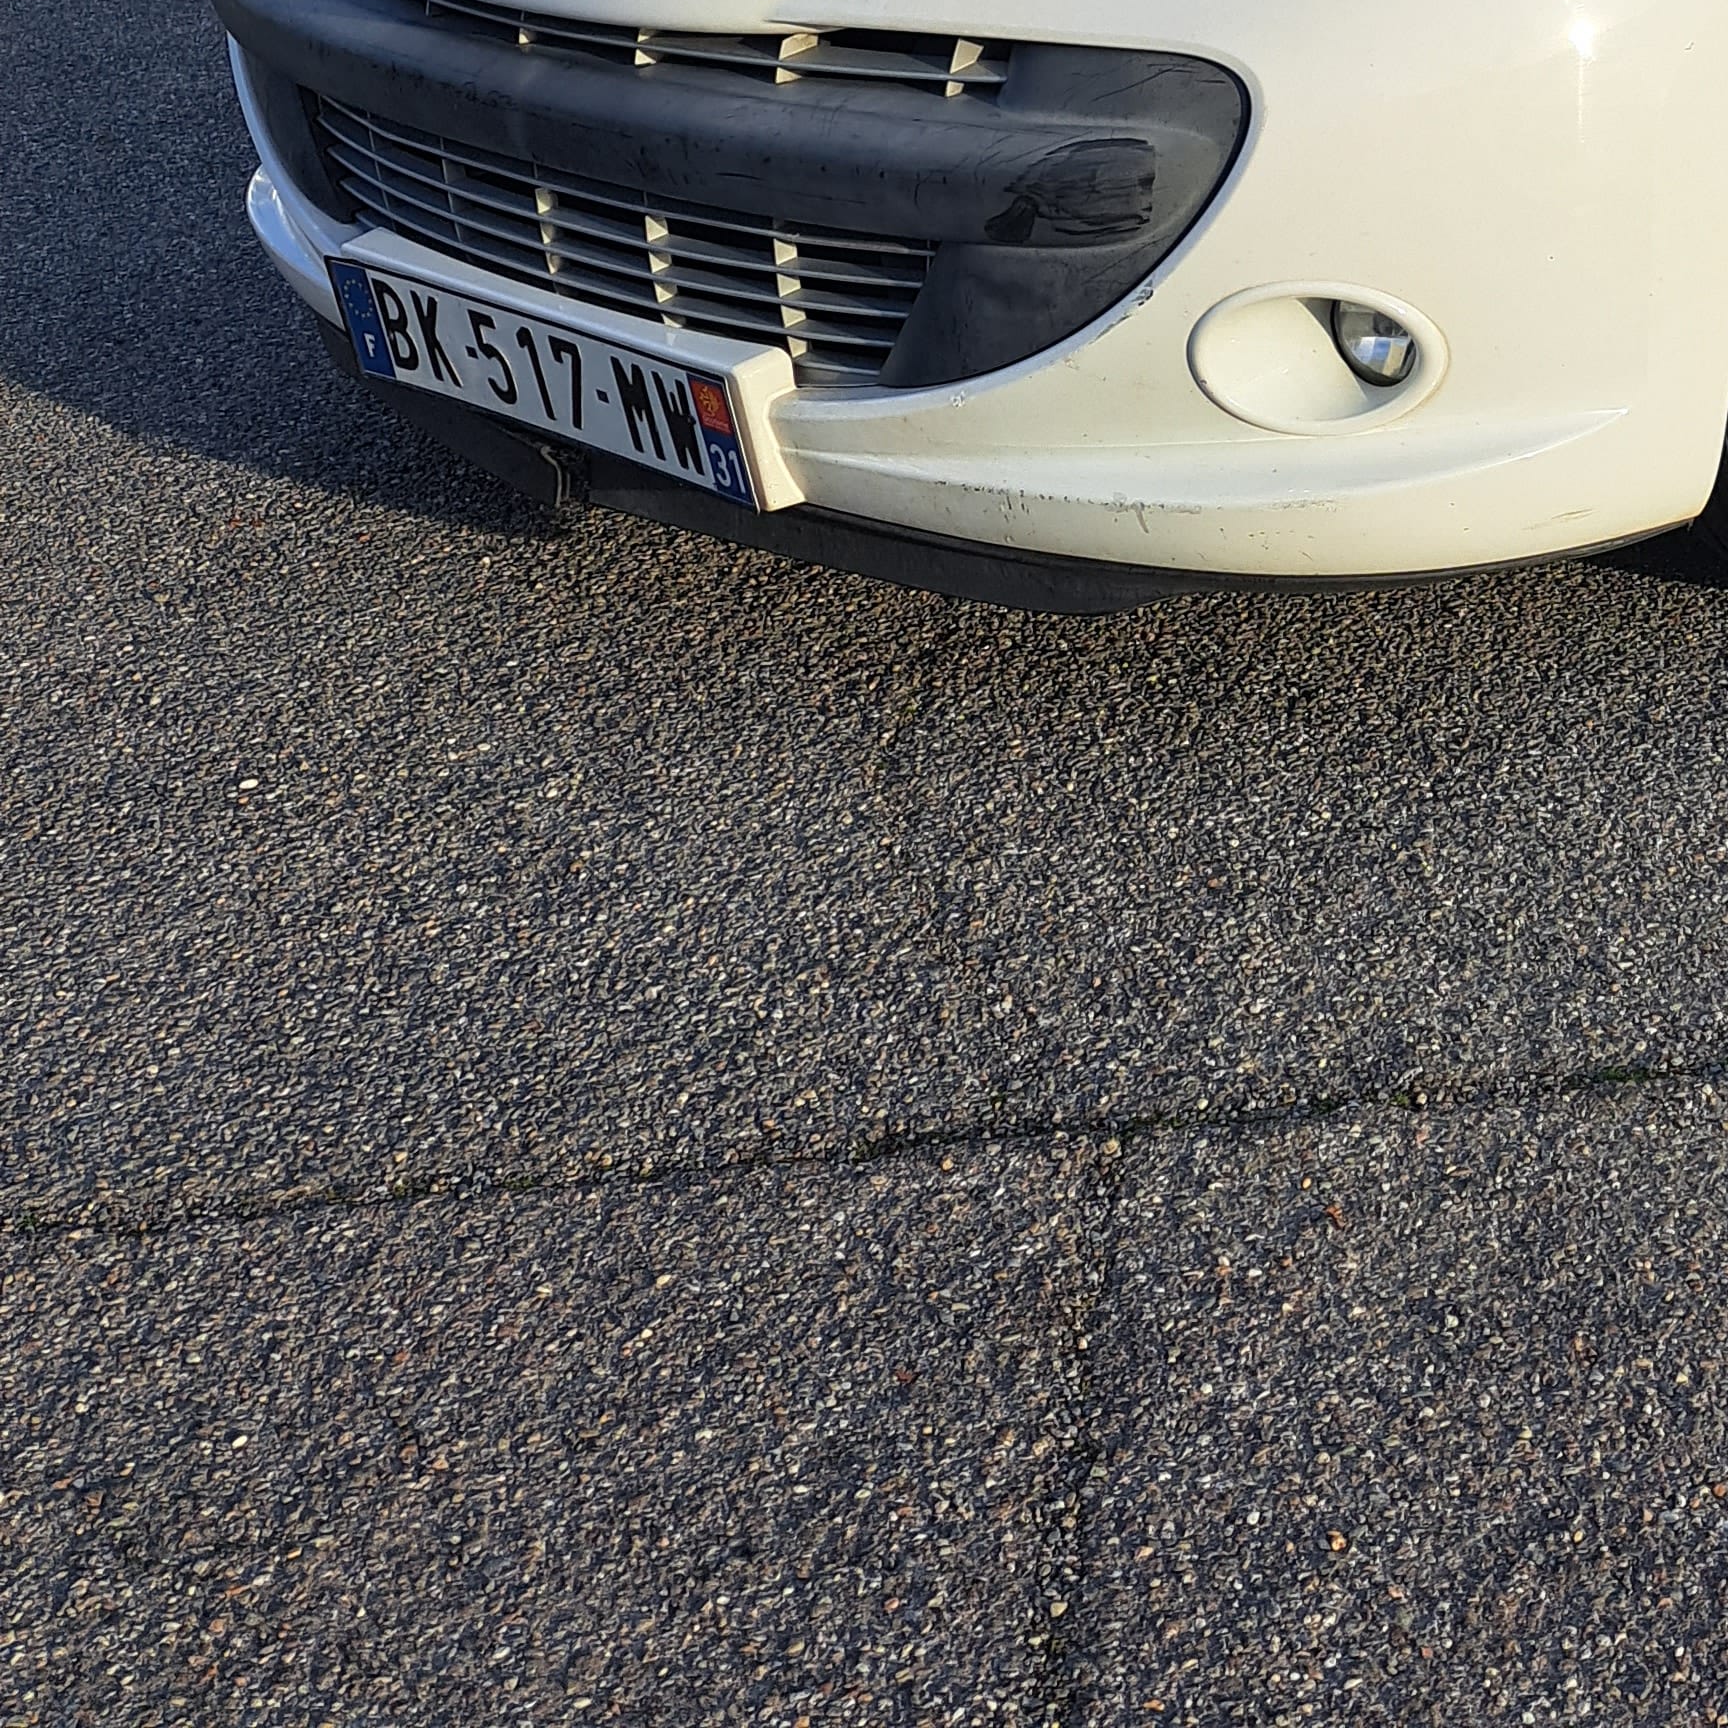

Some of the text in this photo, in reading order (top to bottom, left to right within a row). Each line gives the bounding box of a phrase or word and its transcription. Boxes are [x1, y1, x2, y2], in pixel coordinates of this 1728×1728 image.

[364, 332, 377, 360] F
[371, 276, 705, 476] BK-517-MW
[709, 442, 747, 494] 31
